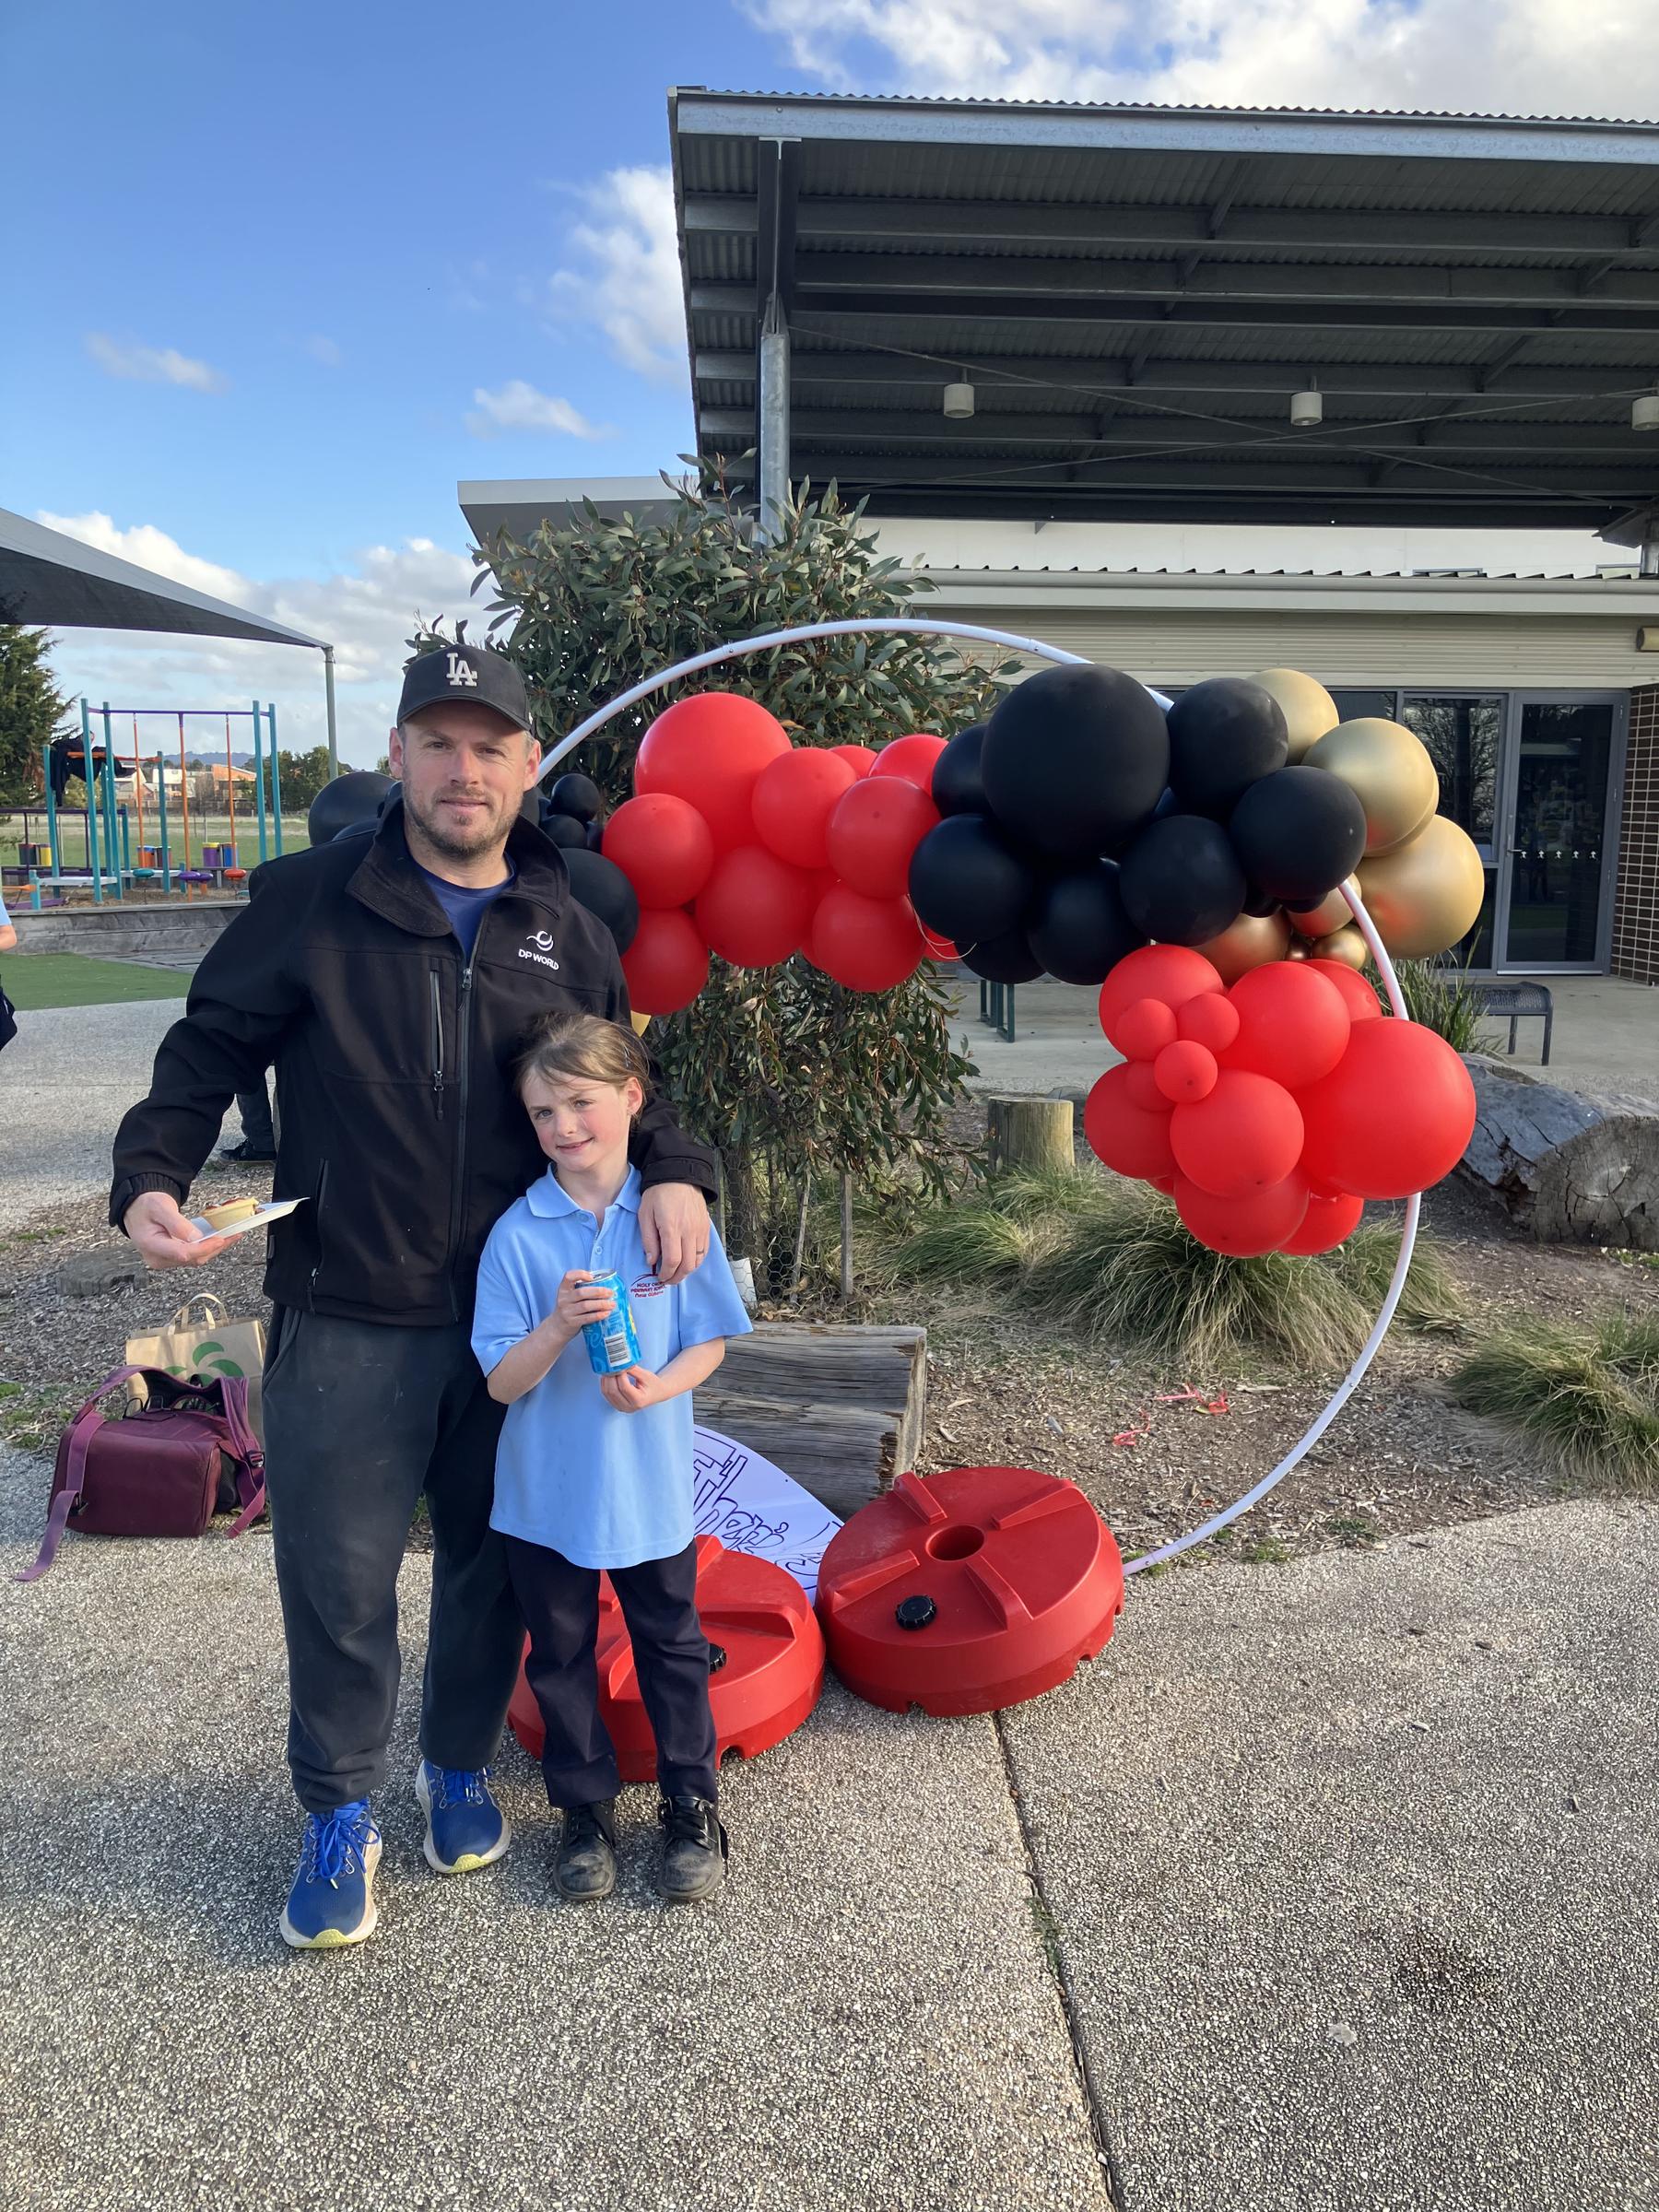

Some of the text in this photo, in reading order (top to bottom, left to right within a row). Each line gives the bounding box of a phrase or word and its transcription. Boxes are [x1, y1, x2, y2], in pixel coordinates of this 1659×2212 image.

[446, 653, 477, 687] LA
[518, 948, 559, 971] DP WORLD
